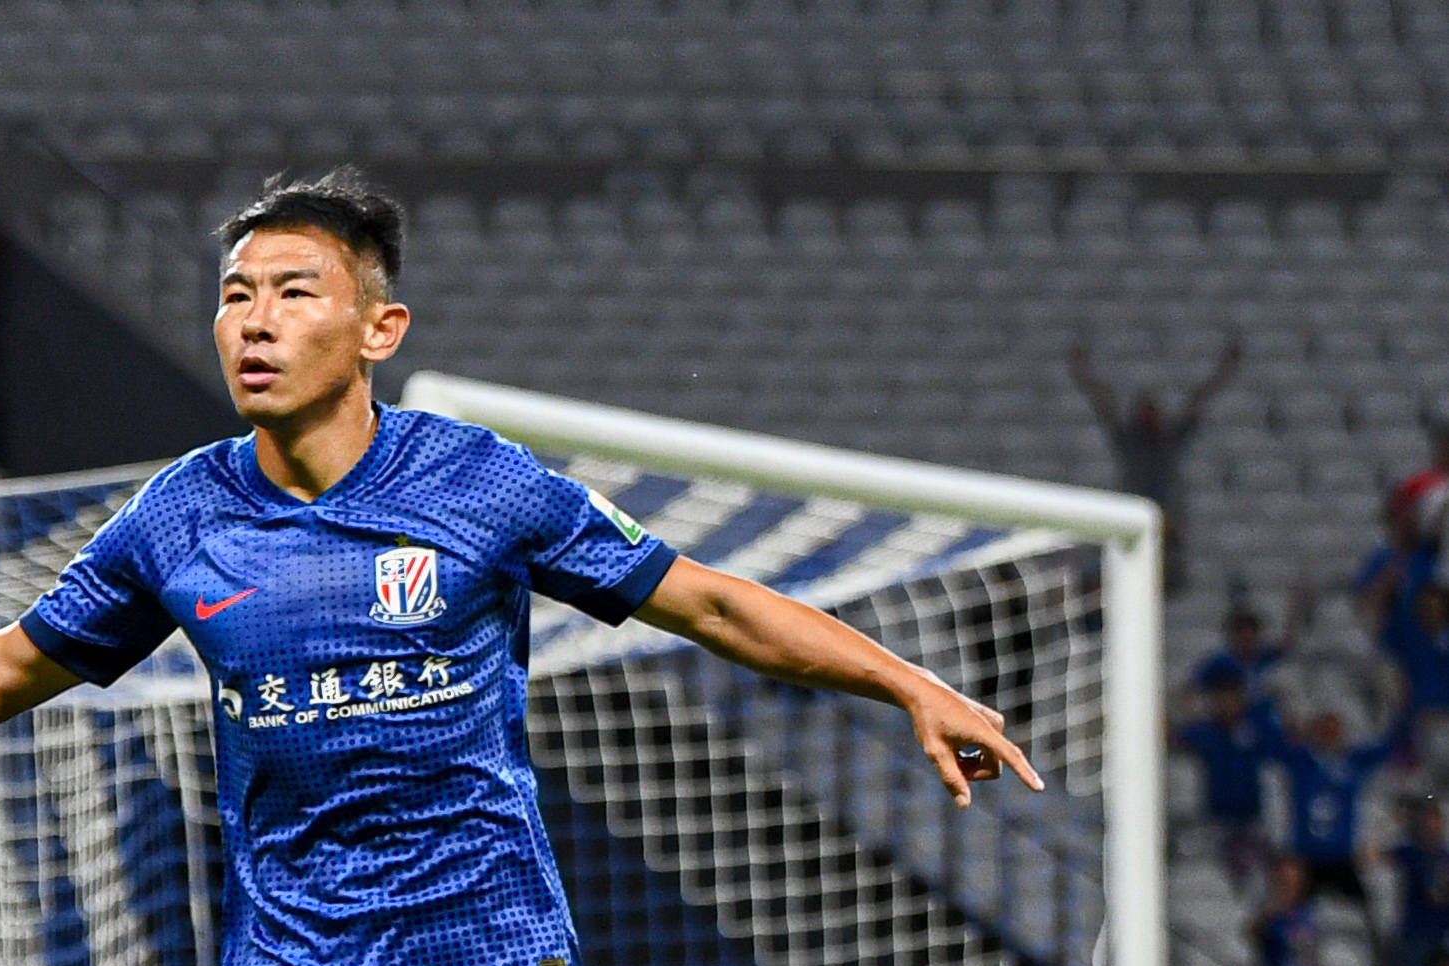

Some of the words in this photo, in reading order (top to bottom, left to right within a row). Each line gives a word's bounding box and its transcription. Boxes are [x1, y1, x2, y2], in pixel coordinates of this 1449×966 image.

[249, 712, 288, 729] BANK
[295, 709, 319, 724] OF
[326, 681, 474, 720] COMMUNICATIONS
[258, 656, 452, 712] 交通銀行
